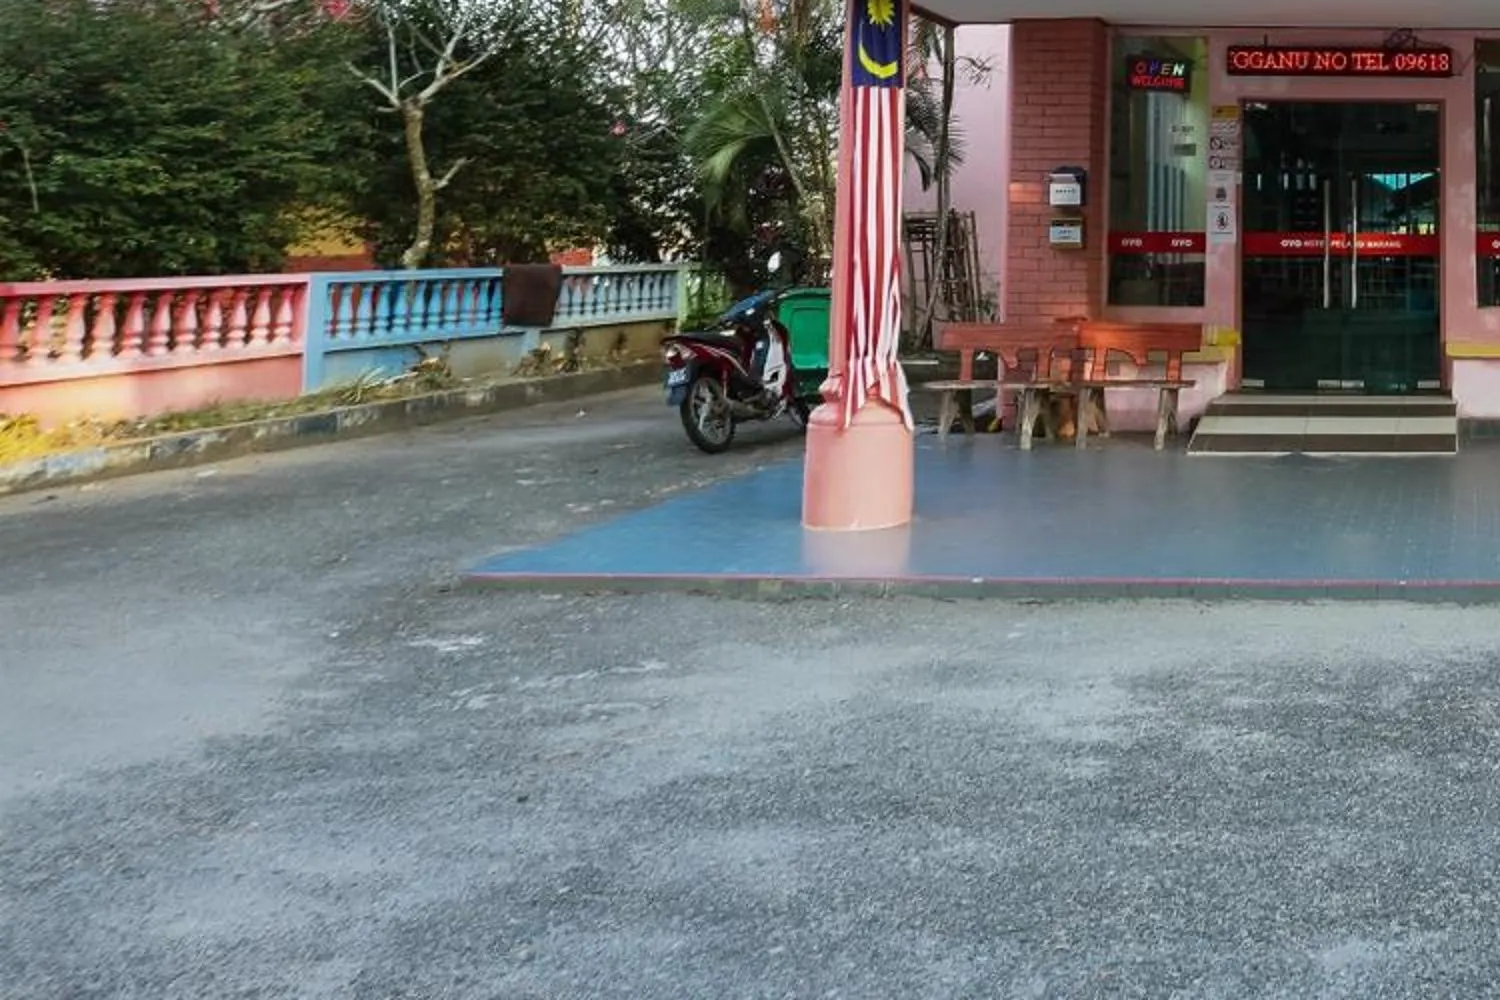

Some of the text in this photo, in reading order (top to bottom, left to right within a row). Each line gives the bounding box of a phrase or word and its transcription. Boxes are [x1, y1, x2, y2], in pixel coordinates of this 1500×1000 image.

[1232, 51, 1450, 71] GGANU NO TEL 09618
